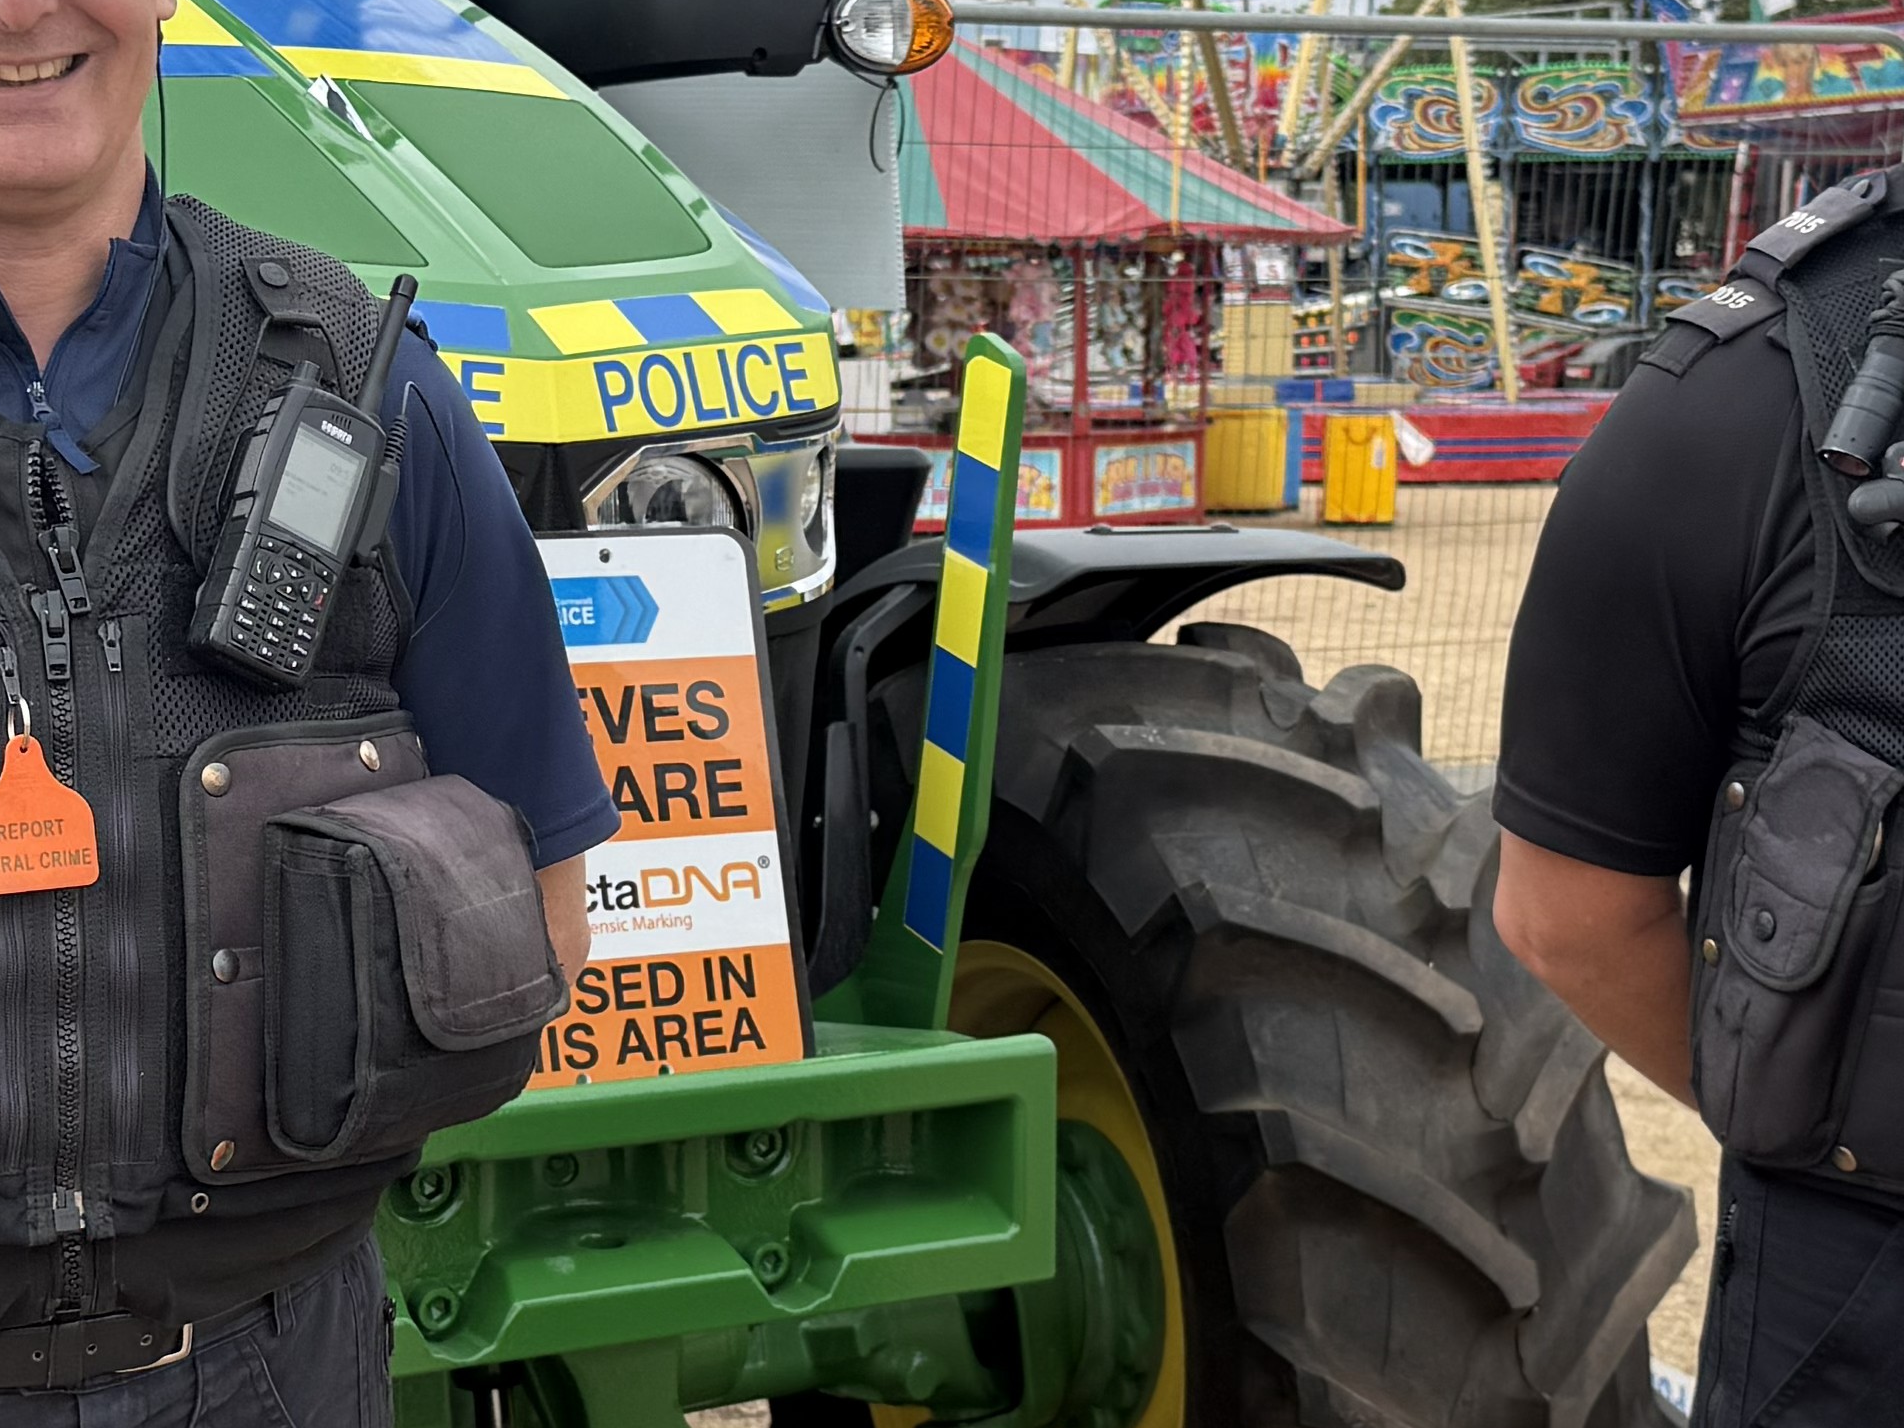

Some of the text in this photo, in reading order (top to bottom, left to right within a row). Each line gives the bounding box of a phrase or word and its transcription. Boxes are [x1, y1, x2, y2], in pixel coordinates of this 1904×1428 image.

[593, 342, 816, 433] POLICE
[39, 848, 92, 869] CRIME
[632, 913, 693, 932] Marking
[702, 953, 756, 1002] IN
[616, 1007, 766, 1065] AREA
